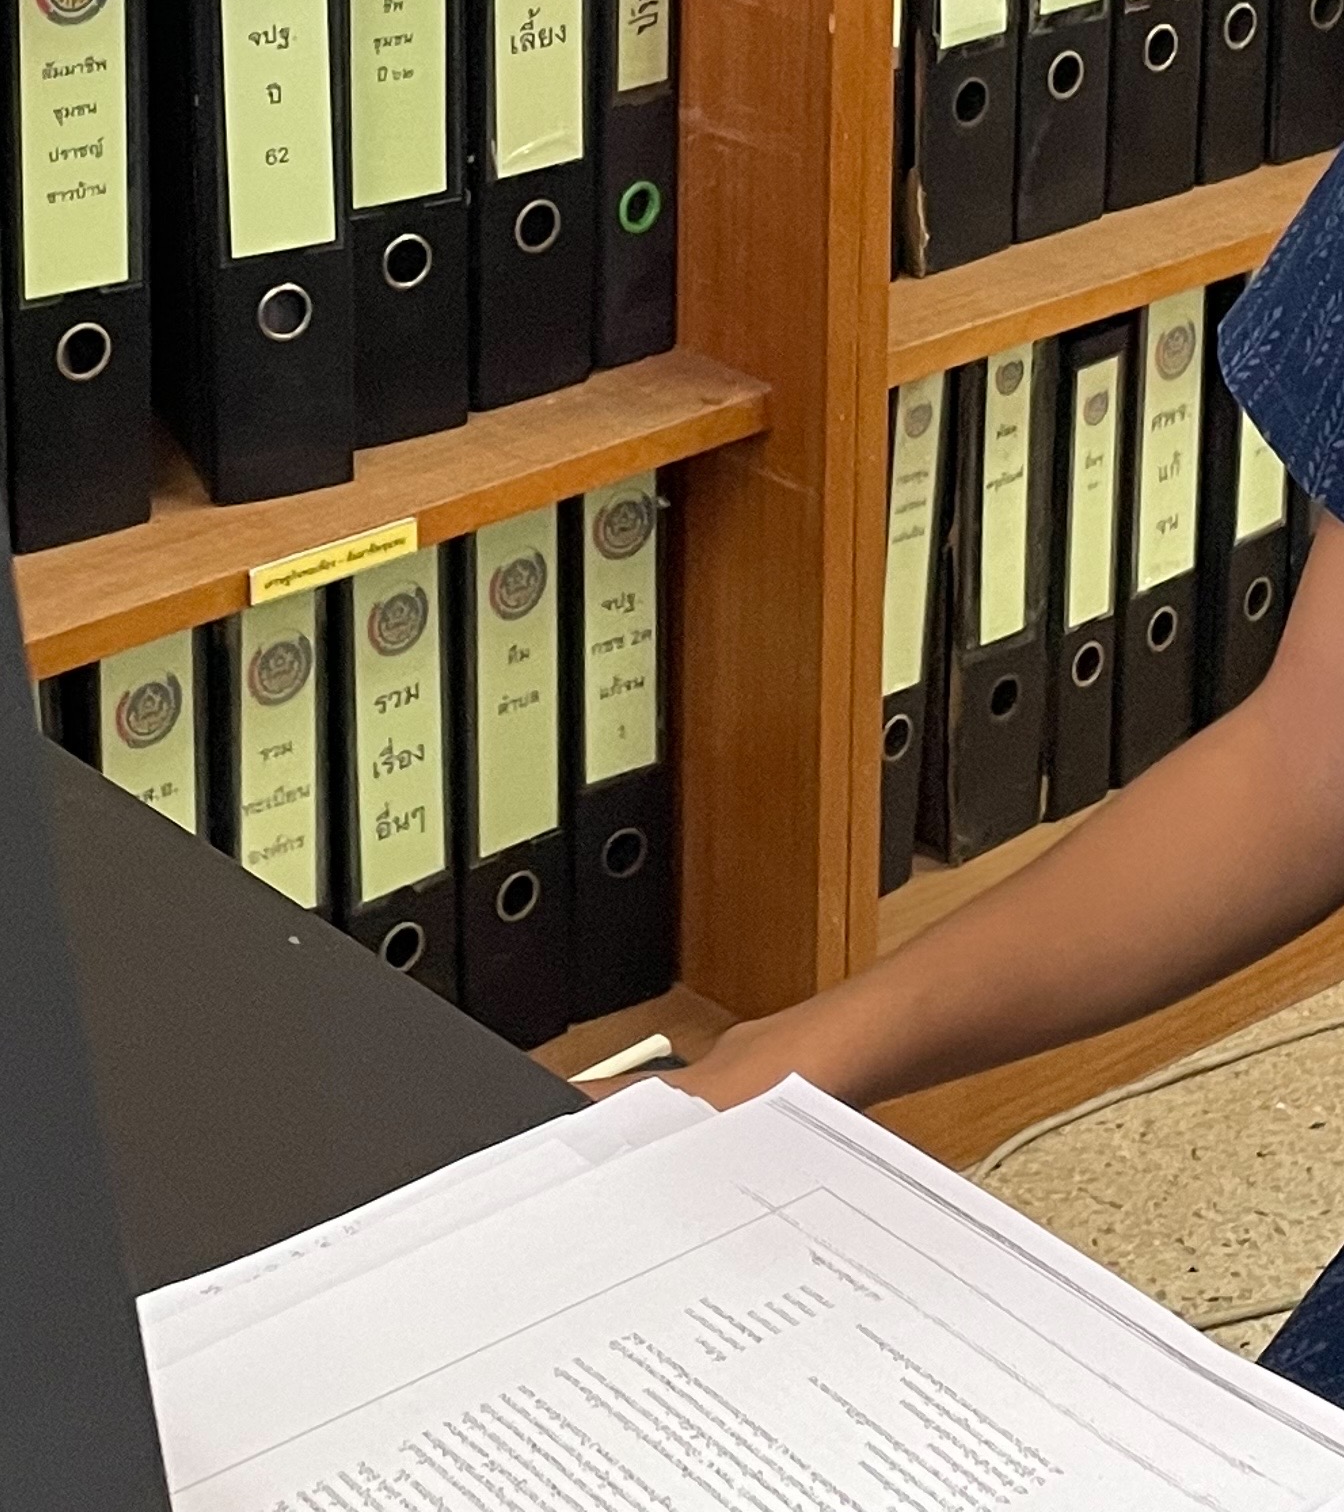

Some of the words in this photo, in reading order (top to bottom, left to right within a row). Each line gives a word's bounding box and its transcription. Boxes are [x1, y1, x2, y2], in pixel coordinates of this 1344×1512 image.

[509, 6, 567, 55] เลี้ยง
[372, 32, 414, 56] ชุมชน
[41, 55, 108, 81] สัมมาชีพ
[266, 82, 282, 105] ปี
[52, 101, 98, 127] ชุมชน
[48, 137, 104, 163] ปราชญ์
[265, 146, 290, 166] 62
[46, 180, 107, 205] ชาวบ้าน
[373, 681, 420, 715] รวม
[372, 736, 425, 779] เรื่อง
[241, 783, 311, 817] ทะเบียน
[375, 800, 426, 841] อื่นๆ
